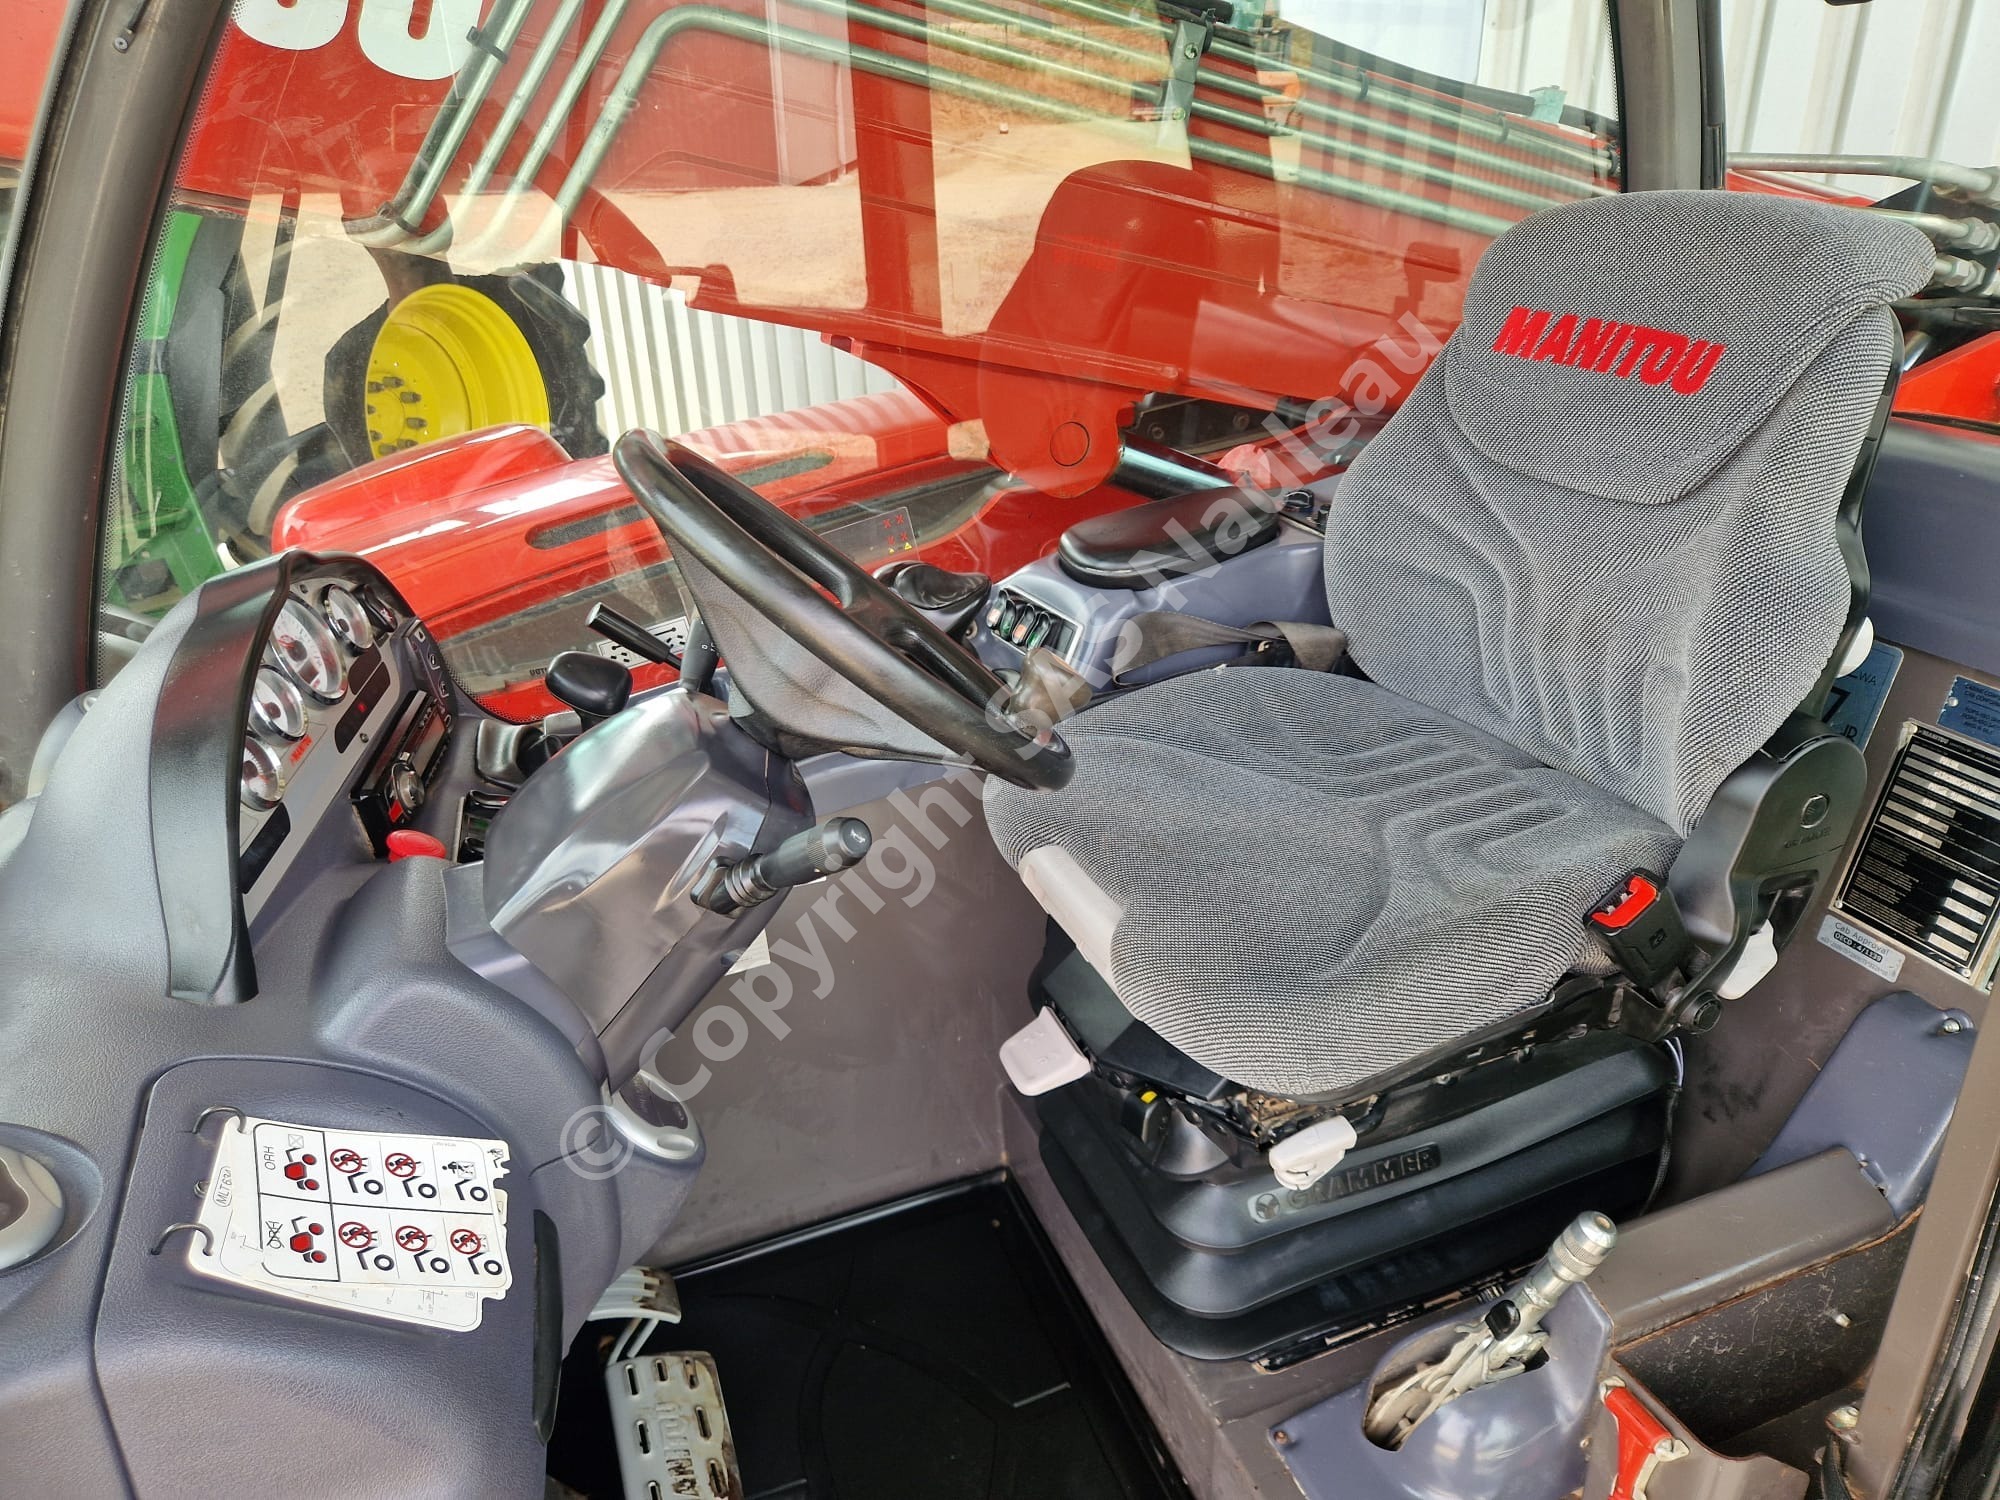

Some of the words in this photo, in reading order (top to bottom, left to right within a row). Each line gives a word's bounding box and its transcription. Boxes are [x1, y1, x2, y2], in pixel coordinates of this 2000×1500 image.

[1492, 305, 1728, 396] MANITOU
[1835, 922, 1851, 935] Cab
[1852, 932, 1890, 956] Approval
[1835, 932, 1853, 946] OECD
[1287, 1147, 1438, 1209] GRAMMER
